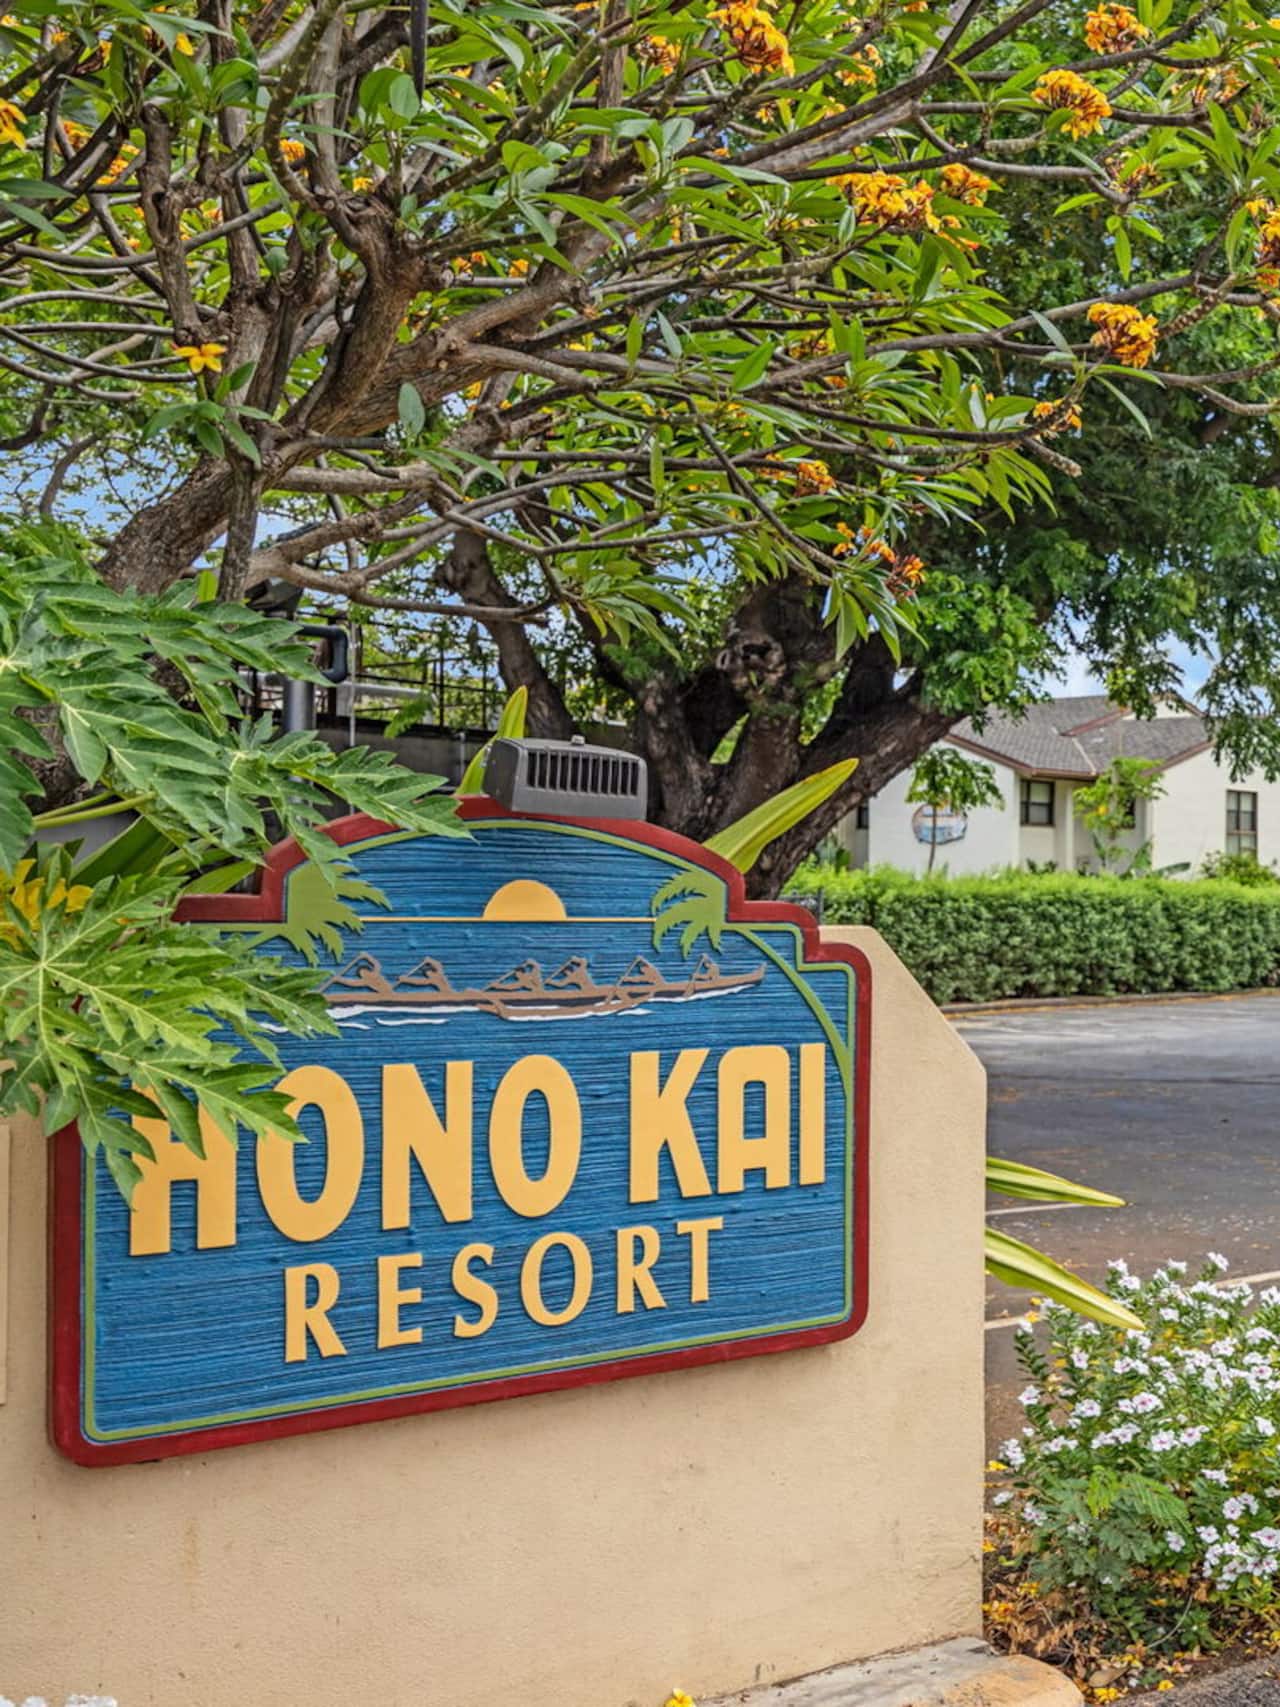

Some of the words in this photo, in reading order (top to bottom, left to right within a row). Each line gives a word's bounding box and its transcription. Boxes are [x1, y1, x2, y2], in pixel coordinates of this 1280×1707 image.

[129, 1054, 583, 1256] HONO
[628, 1043, 826, 1204] KAI
[283, 1217, 724, 1364] RESORT
